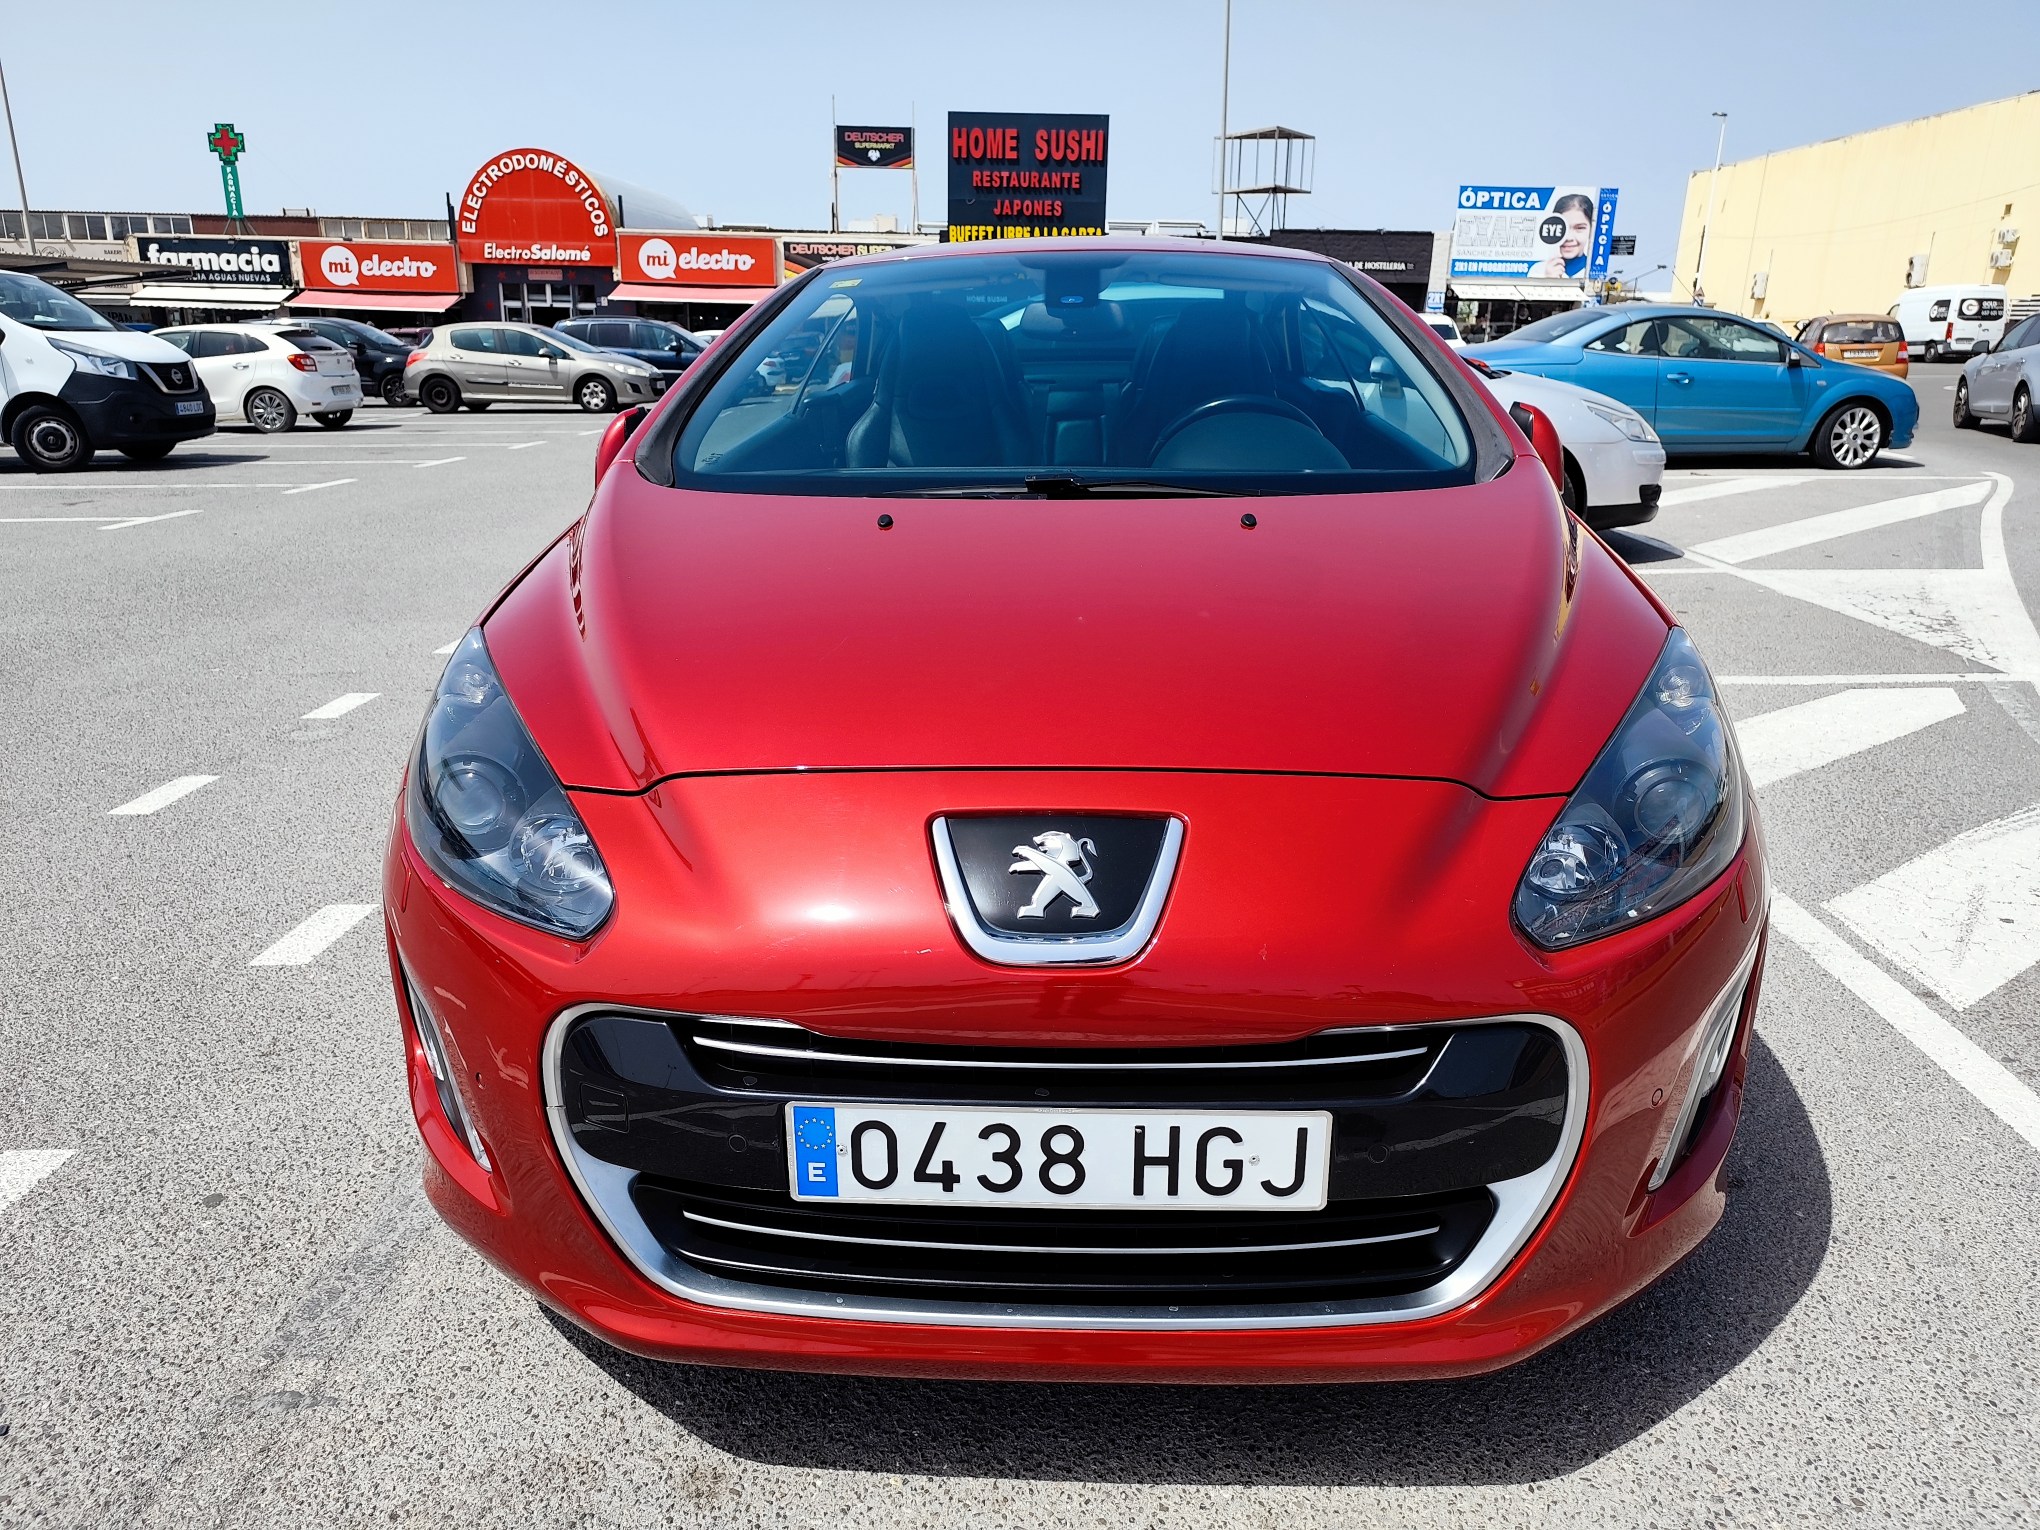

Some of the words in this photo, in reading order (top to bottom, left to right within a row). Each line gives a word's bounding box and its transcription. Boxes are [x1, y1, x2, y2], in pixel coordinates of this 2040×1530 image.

[844, 131, 905, 143] DEUTSCHER
[854, 142, 896, 150] SUPERMARKT
[952, 127, 1018, 159] HOME
[1034, 129, 1104, 161] SUSHI
[972, 170, 1081, 189] RESTAURANTE
[226, 166, 239, 217] FARMACIA
[461, 153, 609, 237] ELECTRODOMÉSTICOS
[1460, 187, 1541, 209] ÓPTICA
[993, 200, 1063, 217] JAPONES
[949, 225, 994, 243] BUFFET
[1541, 224, 1563, 237] EYE
[147, 243, 281, 273] farmacia
[646, 251, 669, 267] mi
[679, 247, 755, 271] electro
[789, 243, 856, 255] DEUTSCHER
[328, 257, 353, 274] mi
[360, 254, 437, 278] electro
[208, 273, 237, 282] AGUAS
[238, 274, 271, 282] NUEVAS
[849, 1119, 1086, 1196] 0438
[1132, 1125, 1309, 1198] HGJ
[808, 1162, 826, 1182] E
